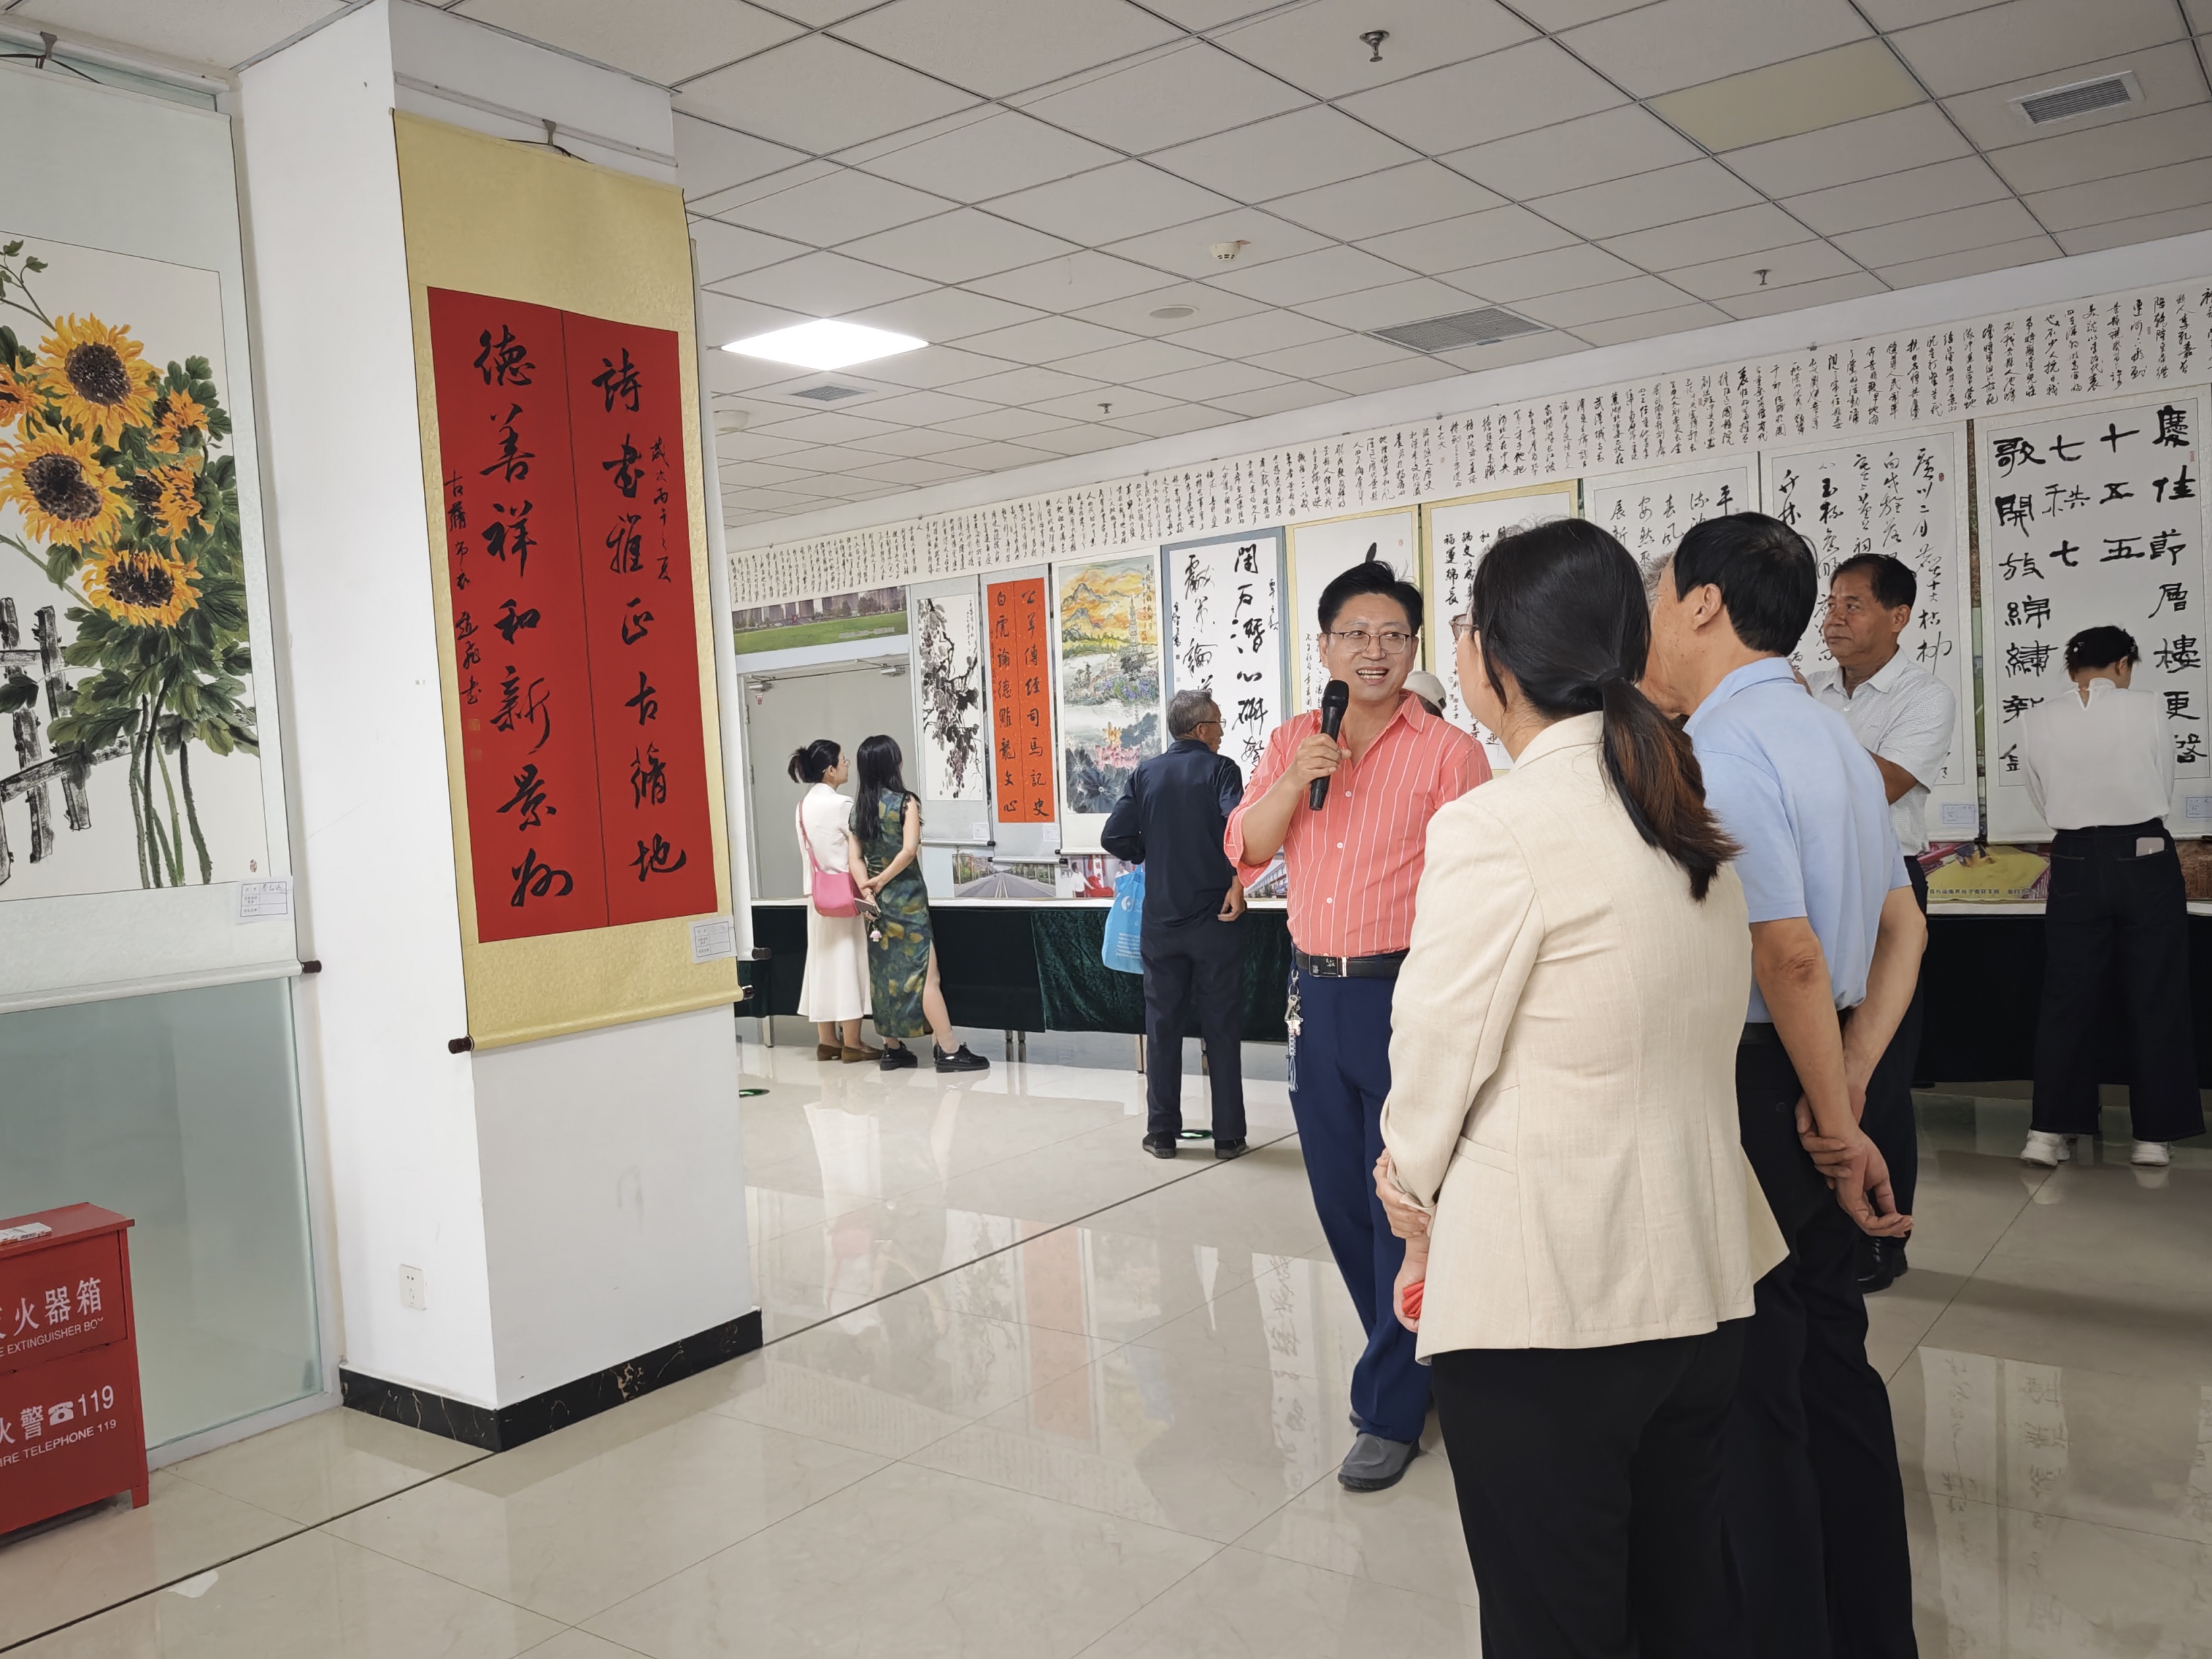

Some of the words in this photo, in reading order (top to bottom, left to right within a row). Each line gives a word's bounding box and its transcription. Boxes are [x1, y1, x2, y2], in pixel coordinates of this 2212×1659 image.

[7, 1324, 82, 1355] EXTINGUISHER
[78, 1385, 114, 1417] 119
[0, 1452, 20, 1467] IRE
[23, 1426, 95, 1458] TELEPHONE
[98, 1419, 117, 1436] 119
